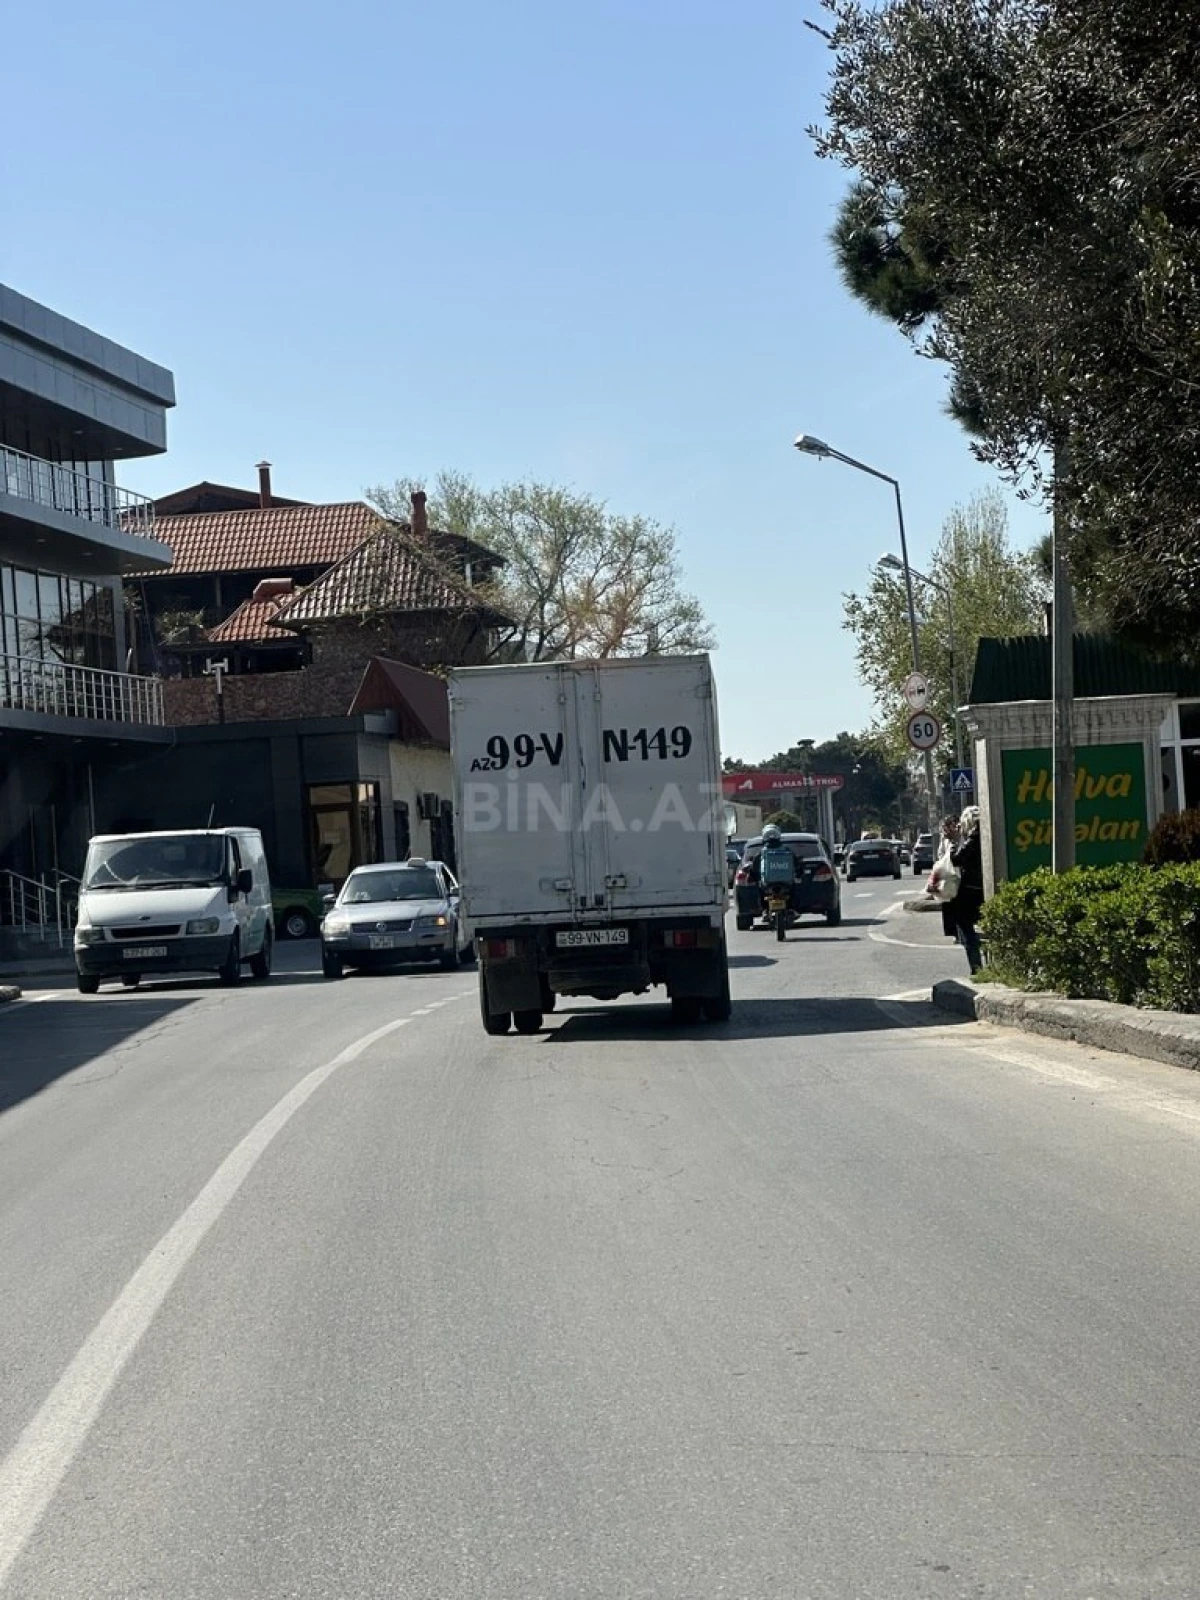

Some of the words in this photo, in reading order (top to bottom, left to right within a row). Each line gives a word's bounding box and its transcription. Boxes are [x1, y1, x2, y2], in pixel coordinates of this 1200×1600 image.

[602, 726, 693, 762] N-149
[913, 722, 934, 738] 50
[1017, 767, 1132, 803] Hlva
[1014, 816, 1140, 852] Şüəlan
